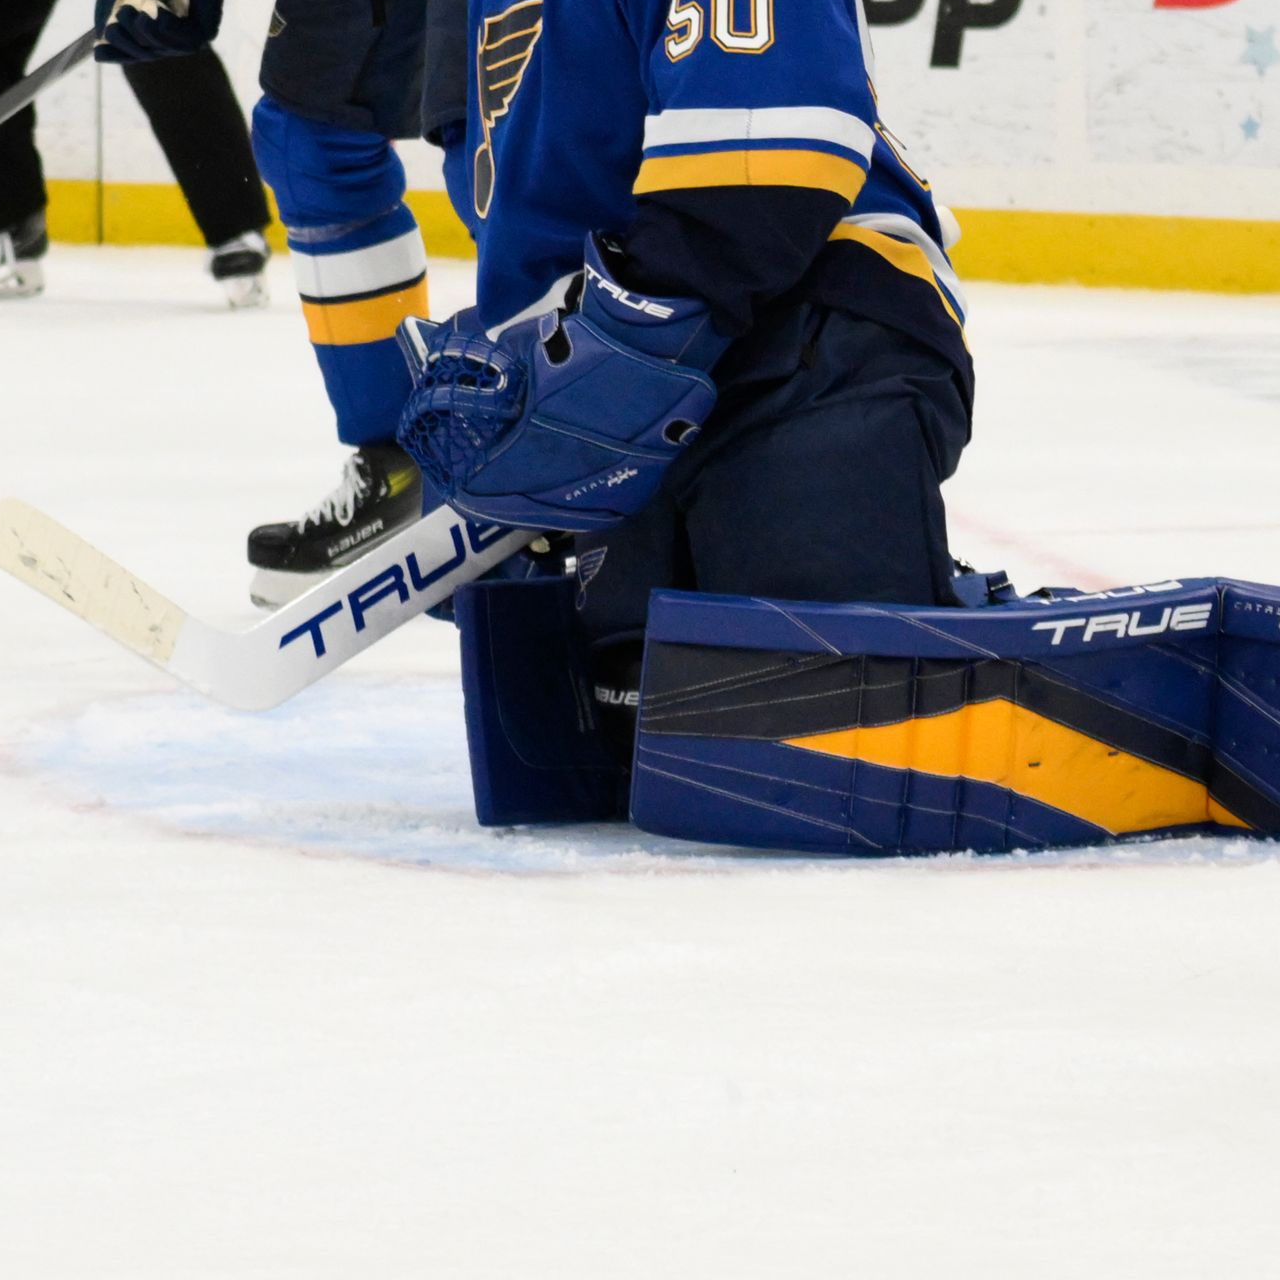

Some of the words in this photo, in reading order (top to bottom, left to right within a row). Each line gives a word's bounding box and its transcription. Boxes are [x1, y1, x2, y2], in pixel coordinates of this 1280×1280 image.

[583, 262, 675, 320] TRUE
[278, 520, 517, 659] TRUE
[1031, 602, 1212, 646] TRUE
